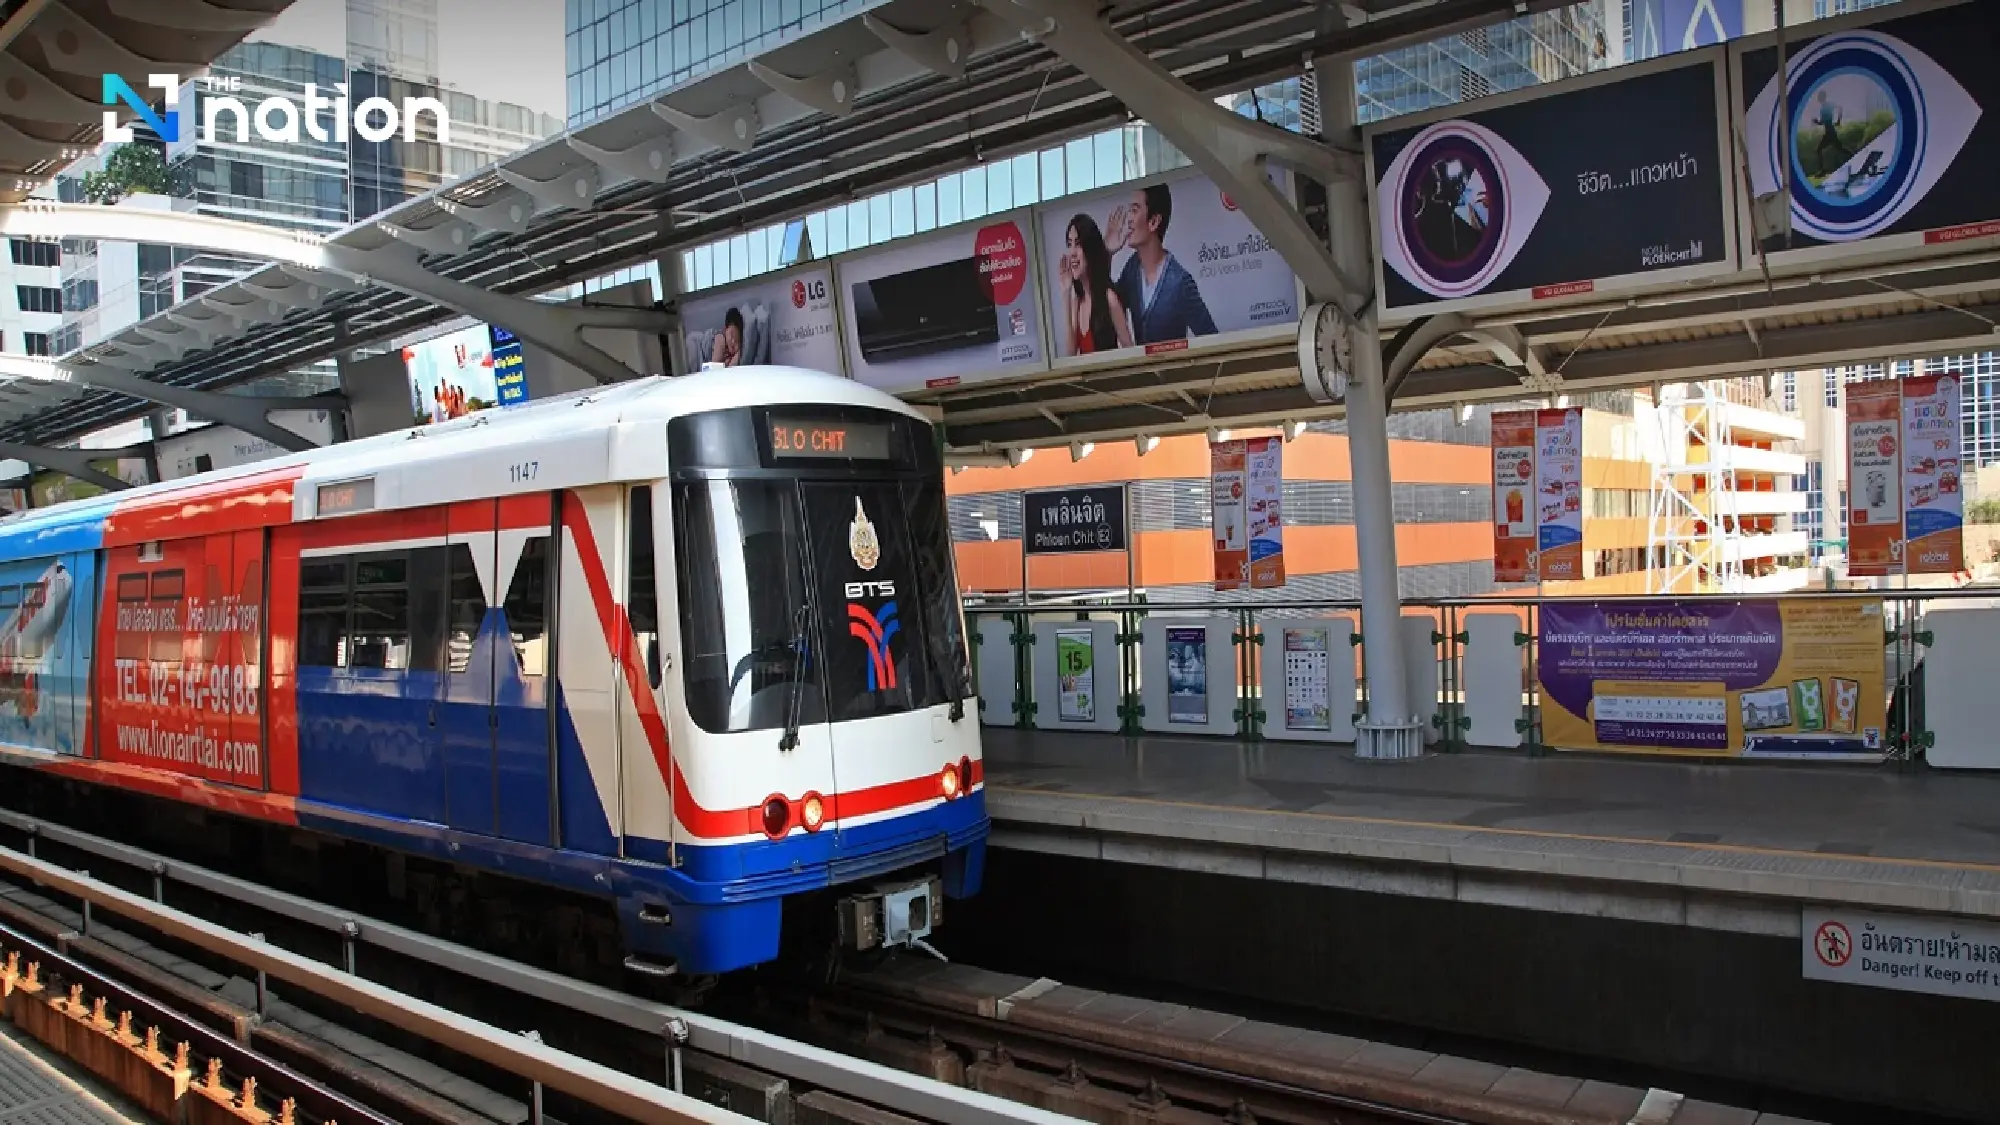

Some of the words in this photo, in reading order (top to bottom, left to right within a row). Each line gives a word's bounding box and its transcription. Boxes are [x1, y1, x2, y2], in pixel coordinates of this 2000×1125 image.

[808, 279, 826, 300] LG
[811, 431, 845, 452] CHIT
[510, 462, 539, 483] 1147
[1041, 494, 1106, 527] เพลินจิต
[1034, 532, 1070, 547] Phloen
[1072, 529, 1095, 546] Chit
[845, 580, 896, 599] BTS
[1065, 650, 1083, 671] 15
[115, 659, 147, 703] TEL.
[1861, 956, 1920, 978] Danger!
[1924, 965, 1961, 984] Keep
[1965, 969, 1989, 984] off
